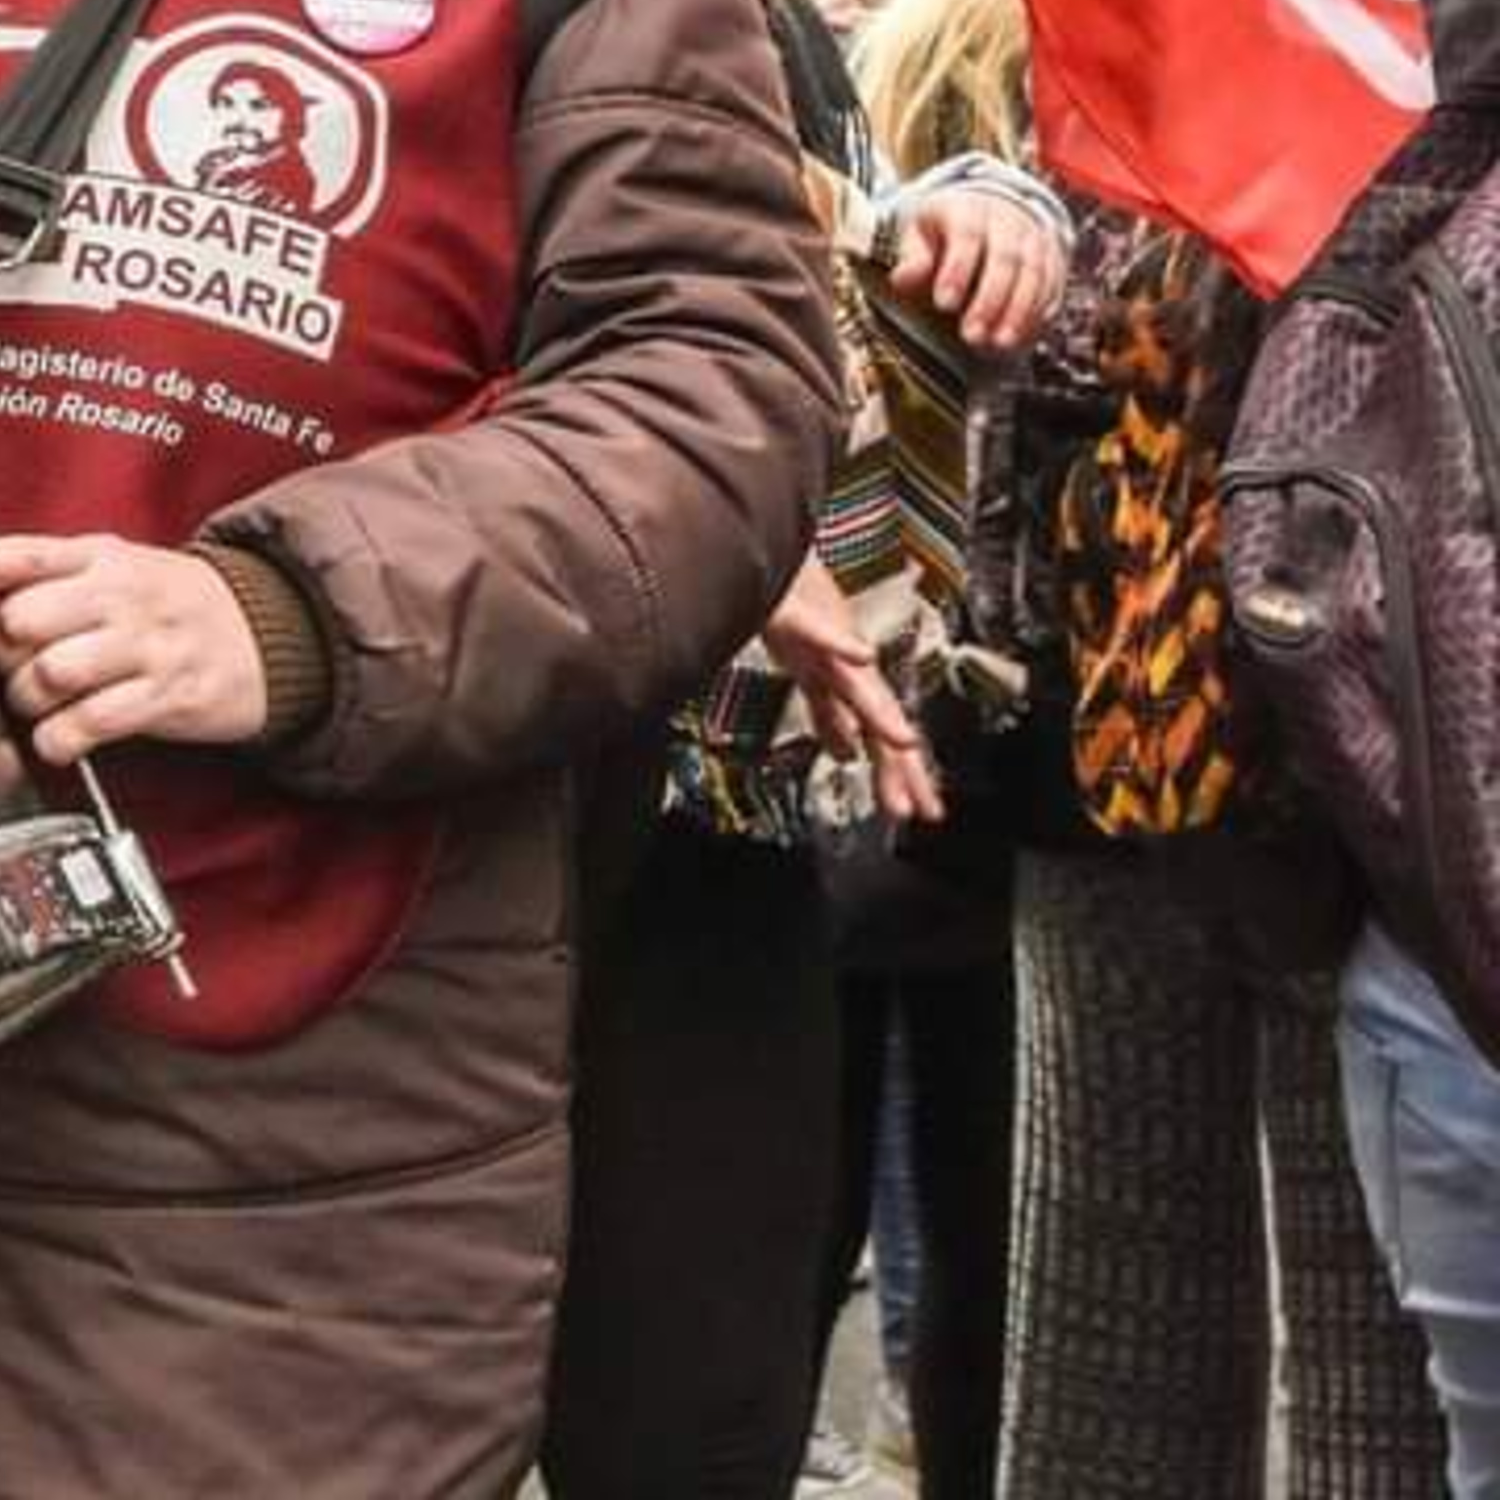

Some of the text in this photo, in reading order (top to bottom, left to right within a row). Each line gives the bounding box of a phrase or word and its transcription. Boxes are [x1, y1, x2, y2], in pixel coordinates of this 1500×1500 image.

[51, 182, 319, 276] AMSAFE
[73, 241, 332, 344] ROSARIO
[54, 392, 186, 446] Rosario
[153, 368, 196, 403] de
[203, 380, 290, 438] Santa
[297, 415, 335, 455] Fe
